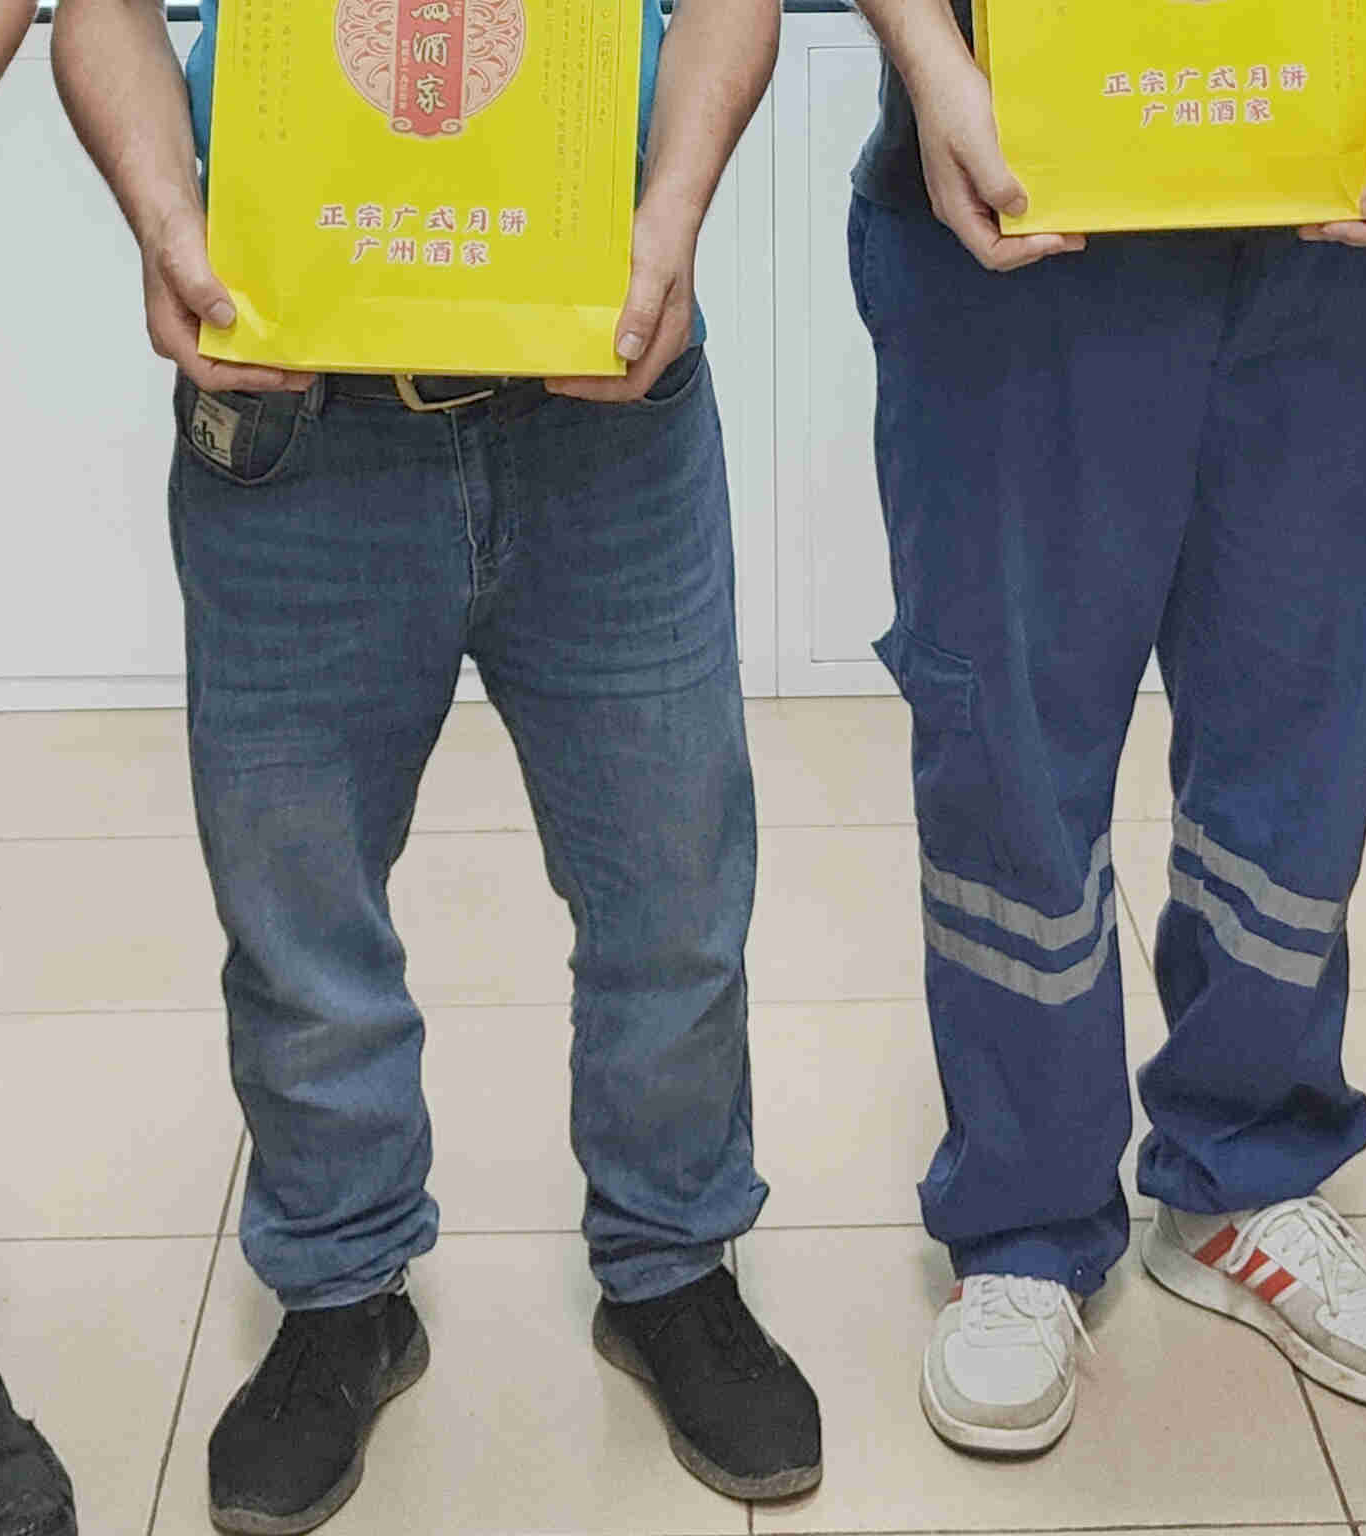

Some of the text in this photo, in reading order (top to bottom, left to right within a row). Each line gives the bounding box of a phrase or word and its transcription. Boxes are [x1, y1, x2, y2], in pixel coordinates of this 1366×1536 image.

[1102, 63, 1307, 96] 正宗广式月饼
[1140, 97, 1273, 126] 广州酒家
[317, 204, 526, 234] 正宗广式月饼
[351, 236, 489, 265] 广州酒家
